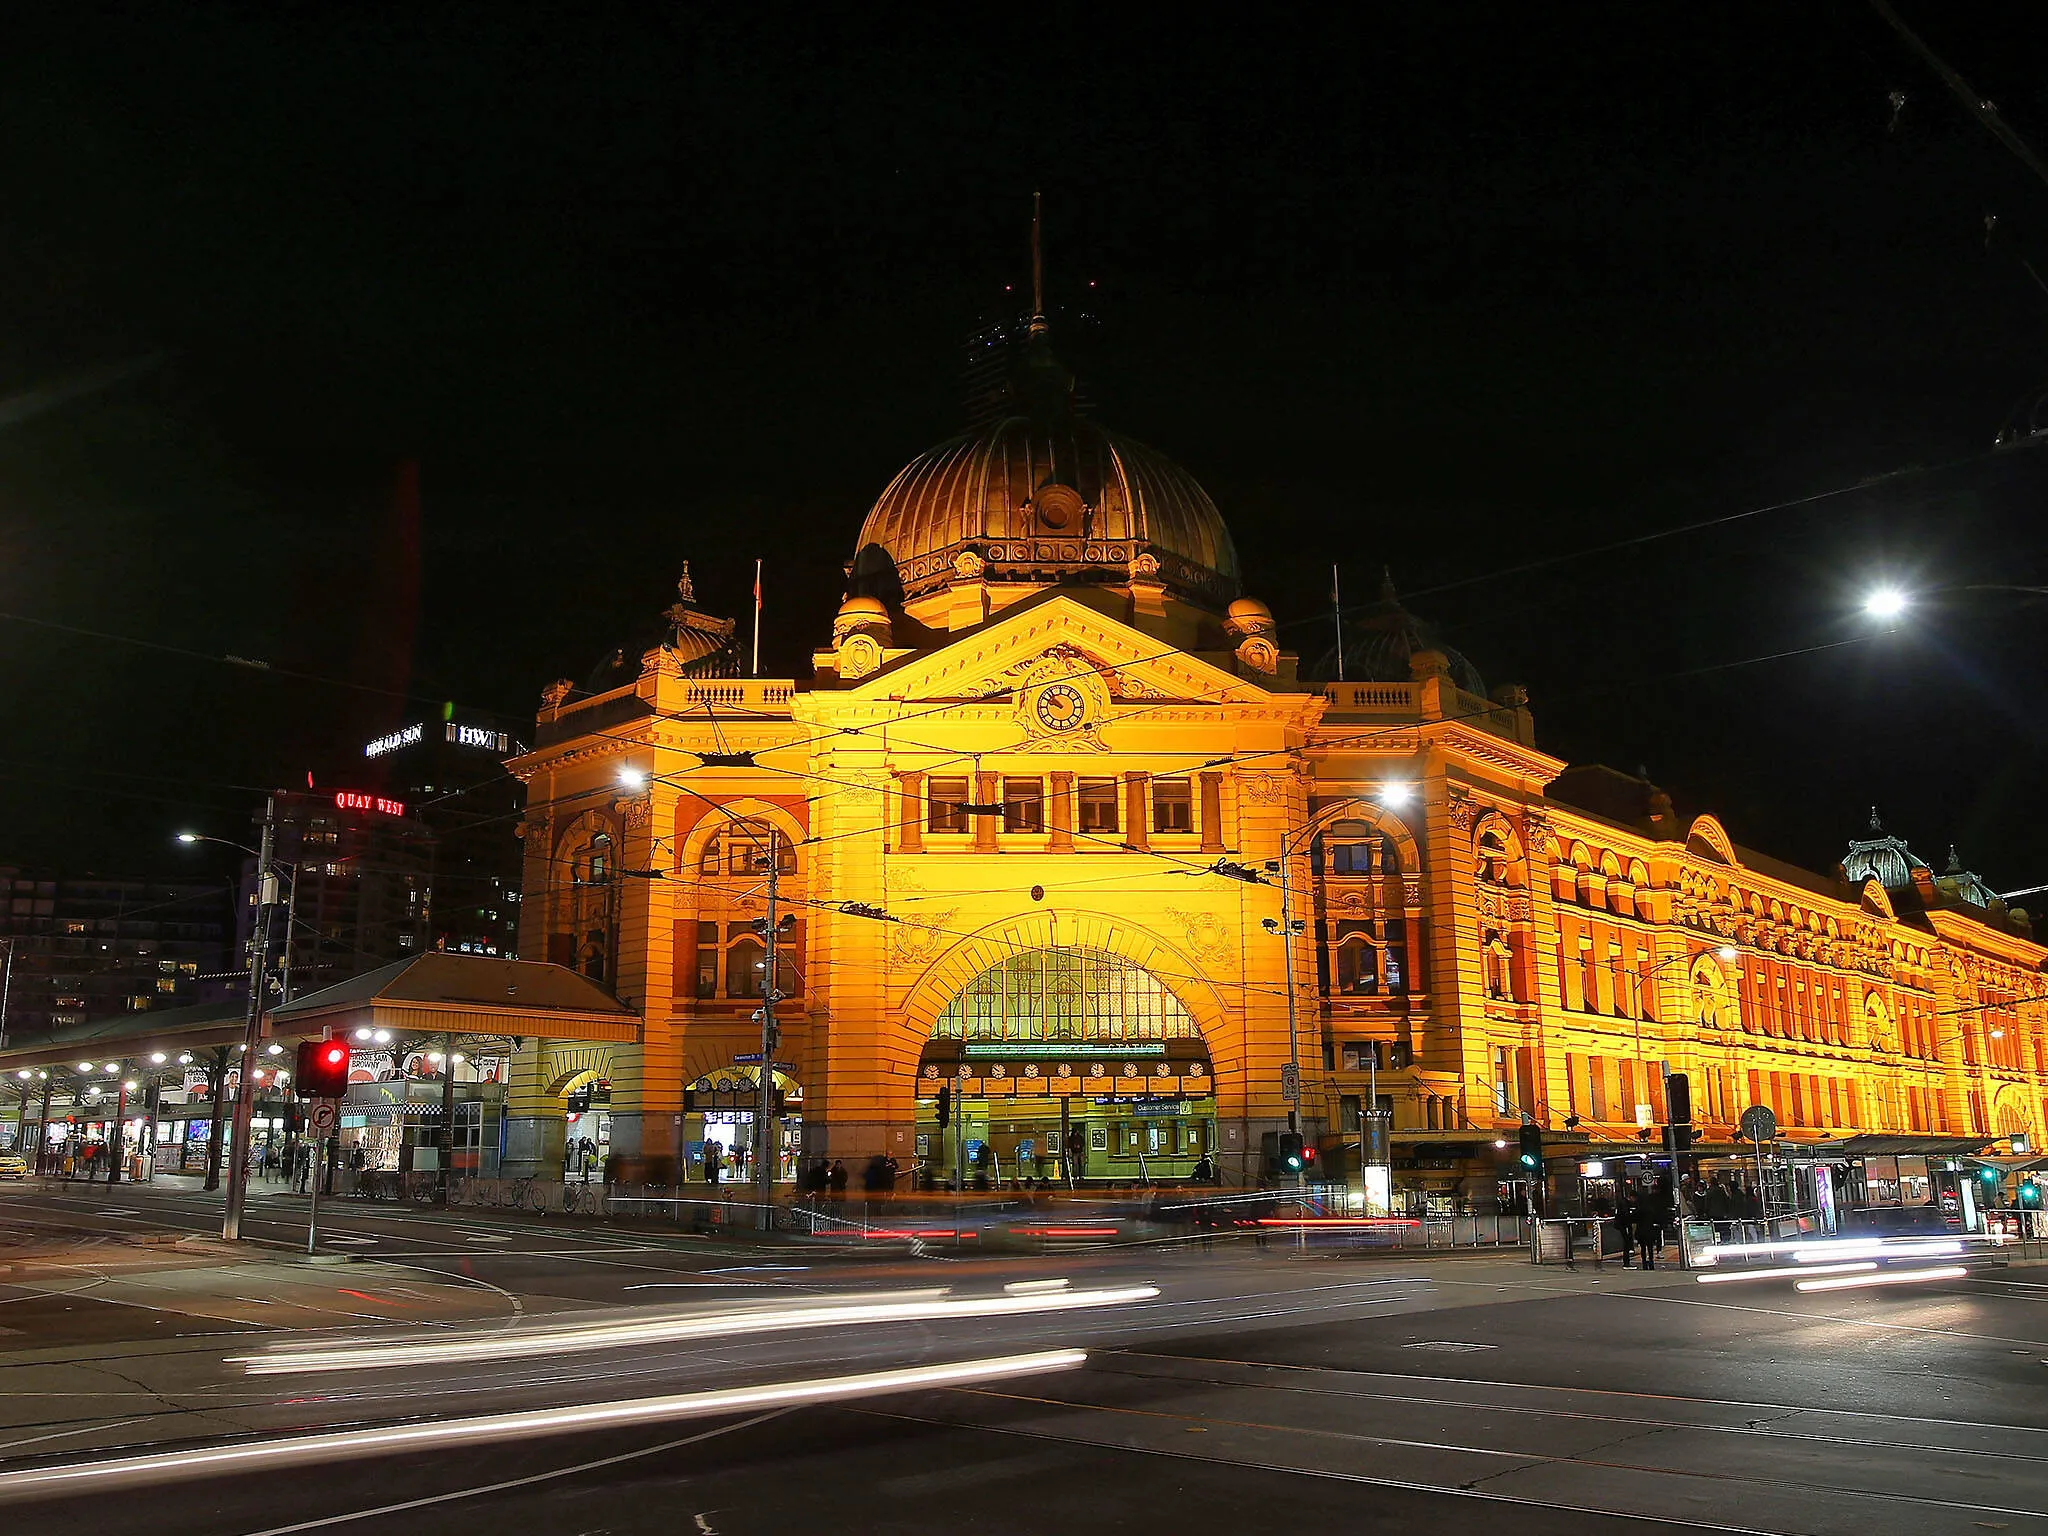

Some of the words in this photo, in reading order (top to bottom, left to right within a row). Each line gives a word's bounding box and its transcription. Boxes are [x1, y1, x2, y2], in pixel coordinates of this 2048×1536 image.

[365, 733, 402, 758] HERALD
[402, 726, 423, 744] SUN
[337, 792, 372, 809] QUAY
[1137, 1104, 1161, 1112] Customer
[1161, 1103, 1180, 1111] Service
